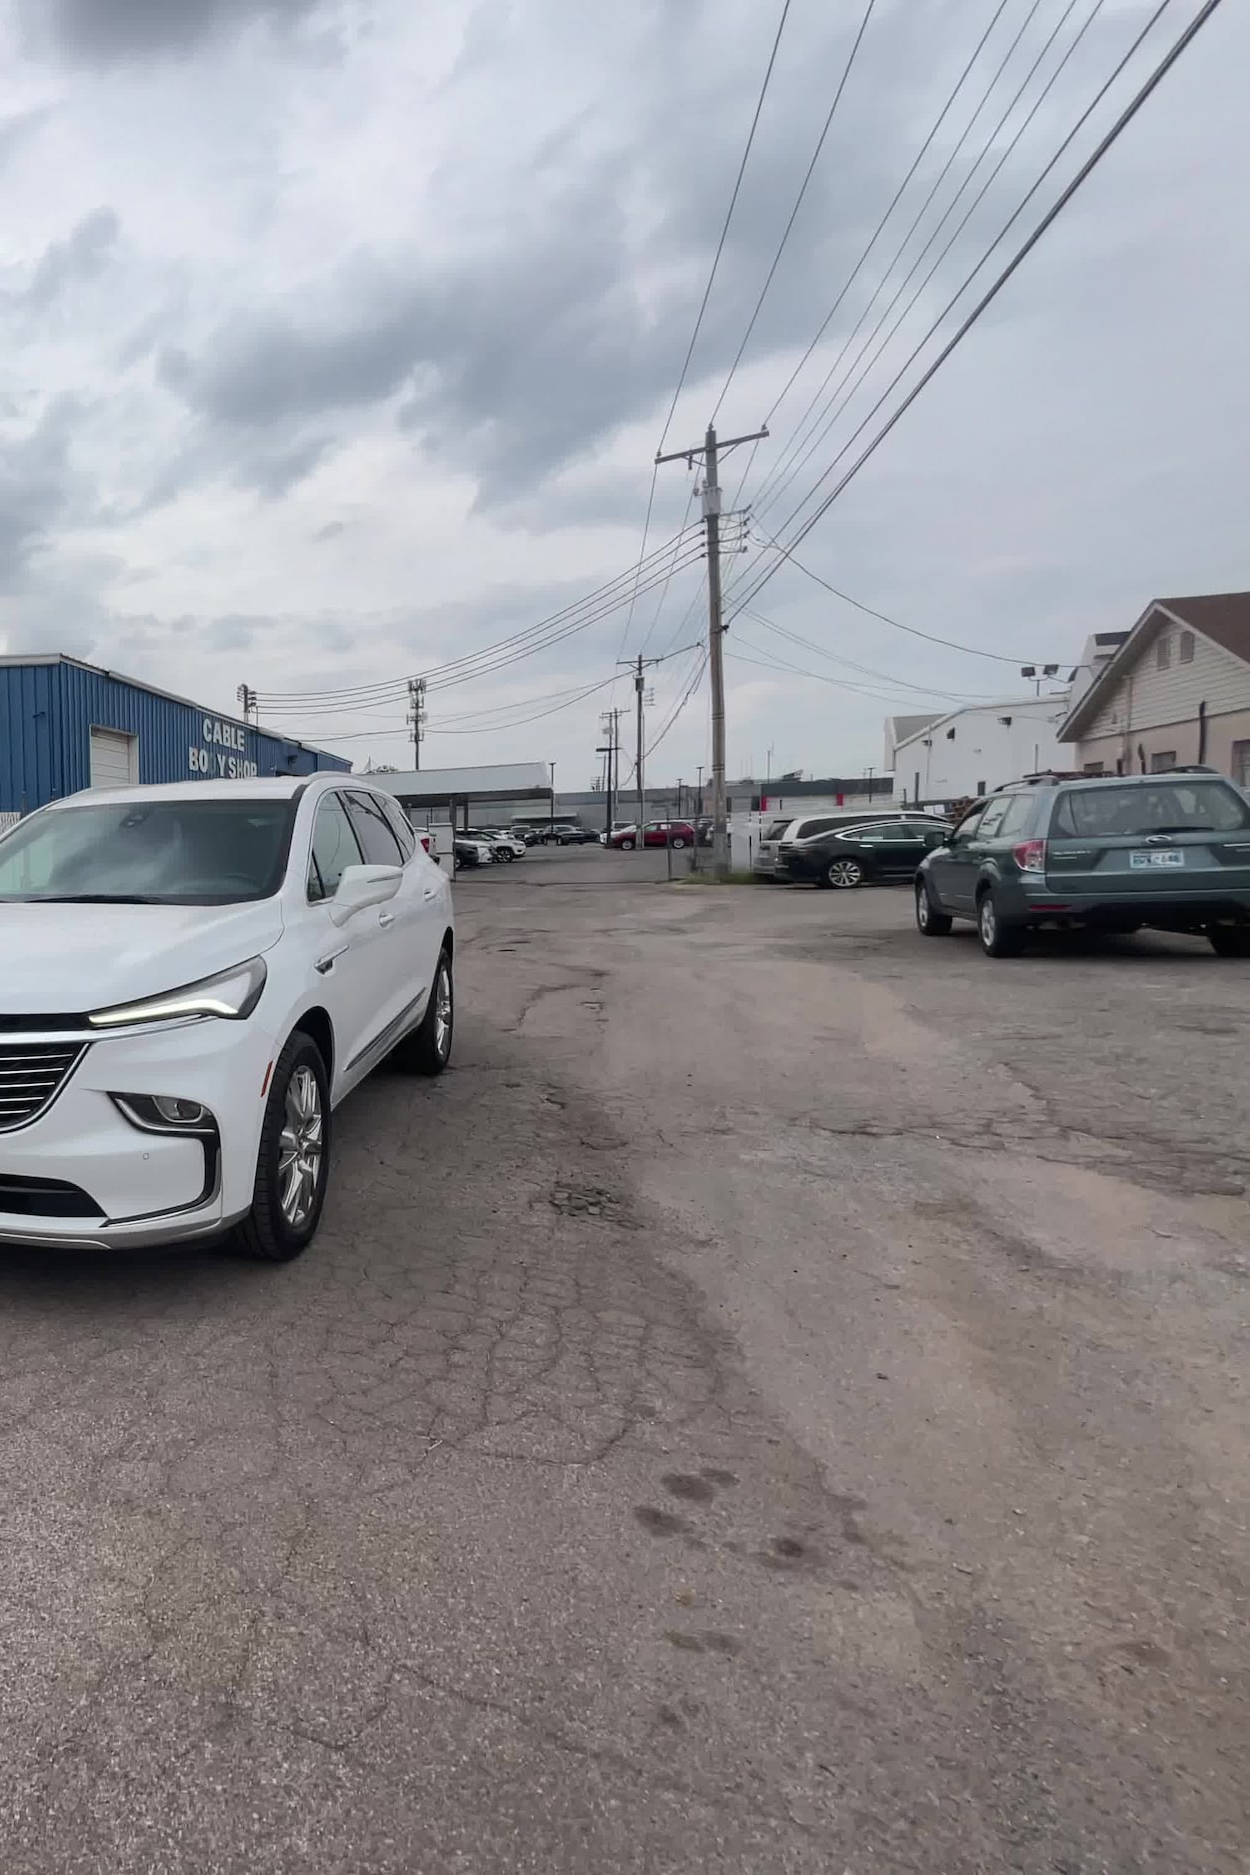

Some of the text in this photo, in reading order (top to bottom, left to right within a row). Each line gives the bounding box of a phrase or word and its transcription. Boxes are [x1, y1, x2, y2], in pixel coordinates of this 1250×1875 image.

[203, 718, 245, 753] CABLE
[189, 746, 258, 779] BOY SHOP
